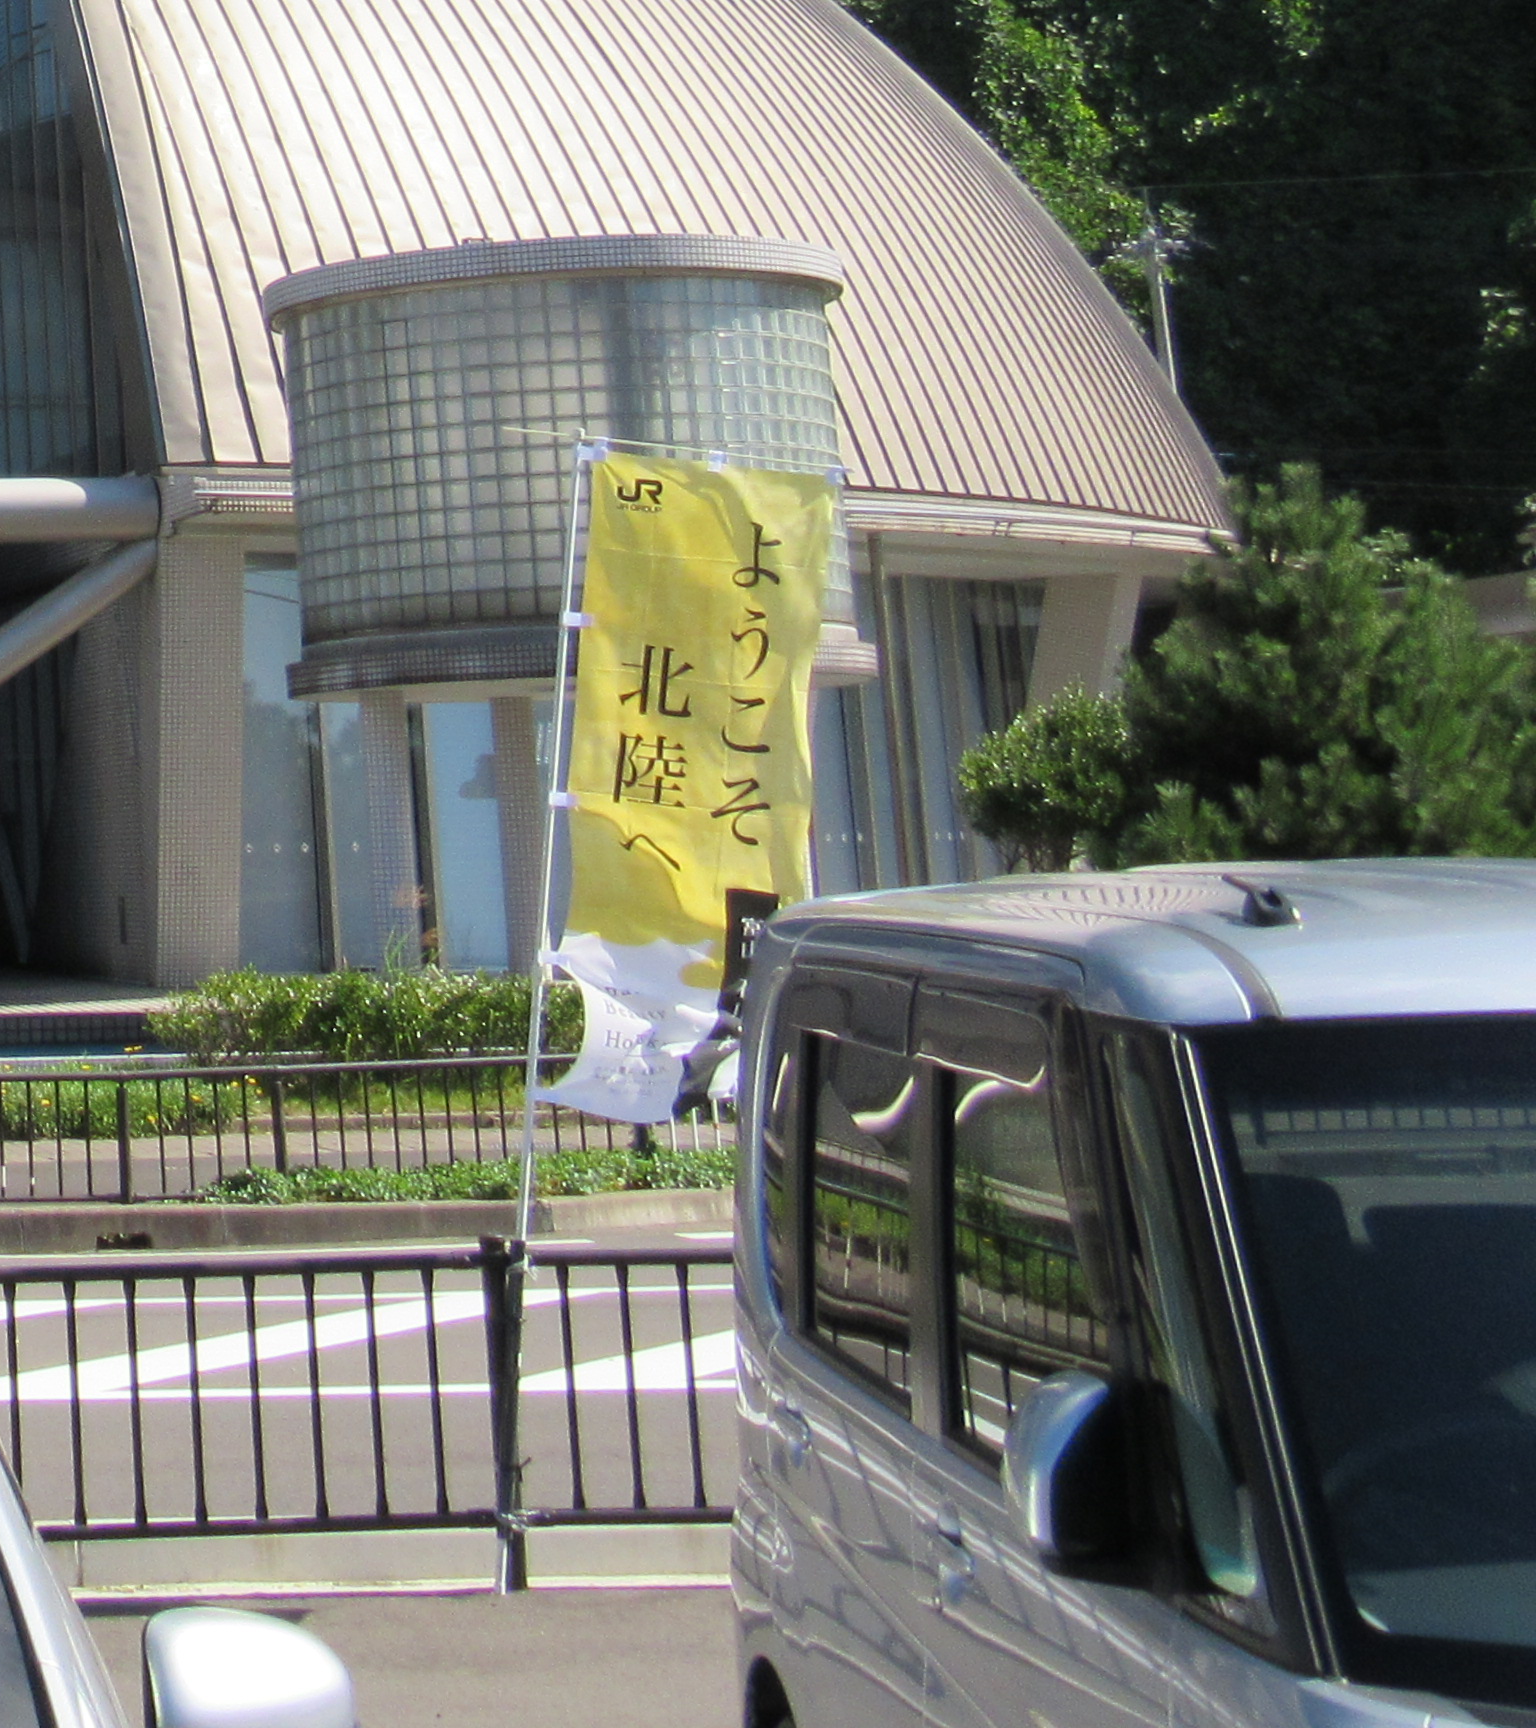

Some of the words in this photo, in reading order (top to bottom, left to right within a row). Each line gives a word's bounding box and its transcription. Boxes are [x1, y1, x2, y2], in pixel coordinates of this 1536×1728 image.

[616, 478, 663, 504] JR
[613, 644, 695, 872] 北陸へ
[711, 522, 782, 846] ようこそ
